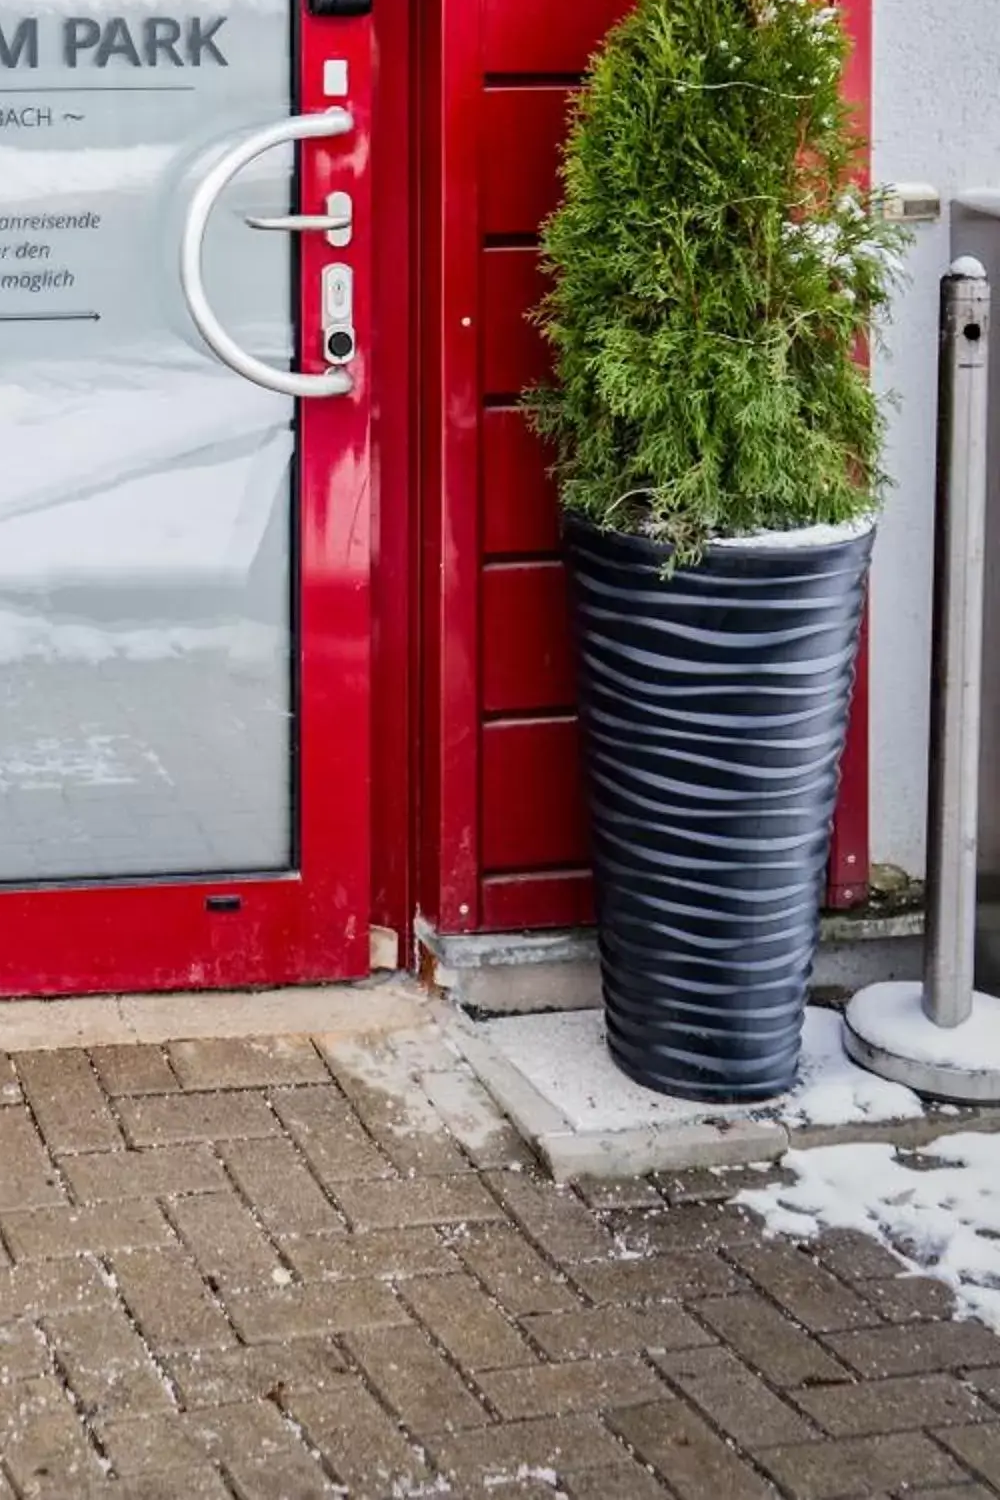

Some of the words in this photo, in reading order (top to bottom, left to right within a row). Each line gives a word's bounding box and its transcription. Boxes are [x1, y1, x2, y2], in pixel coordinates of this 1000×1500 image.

[62, 16, 229, 67] PARK
[15, 241, 51, 260] den
[1, 268, 75, 293] möglich
